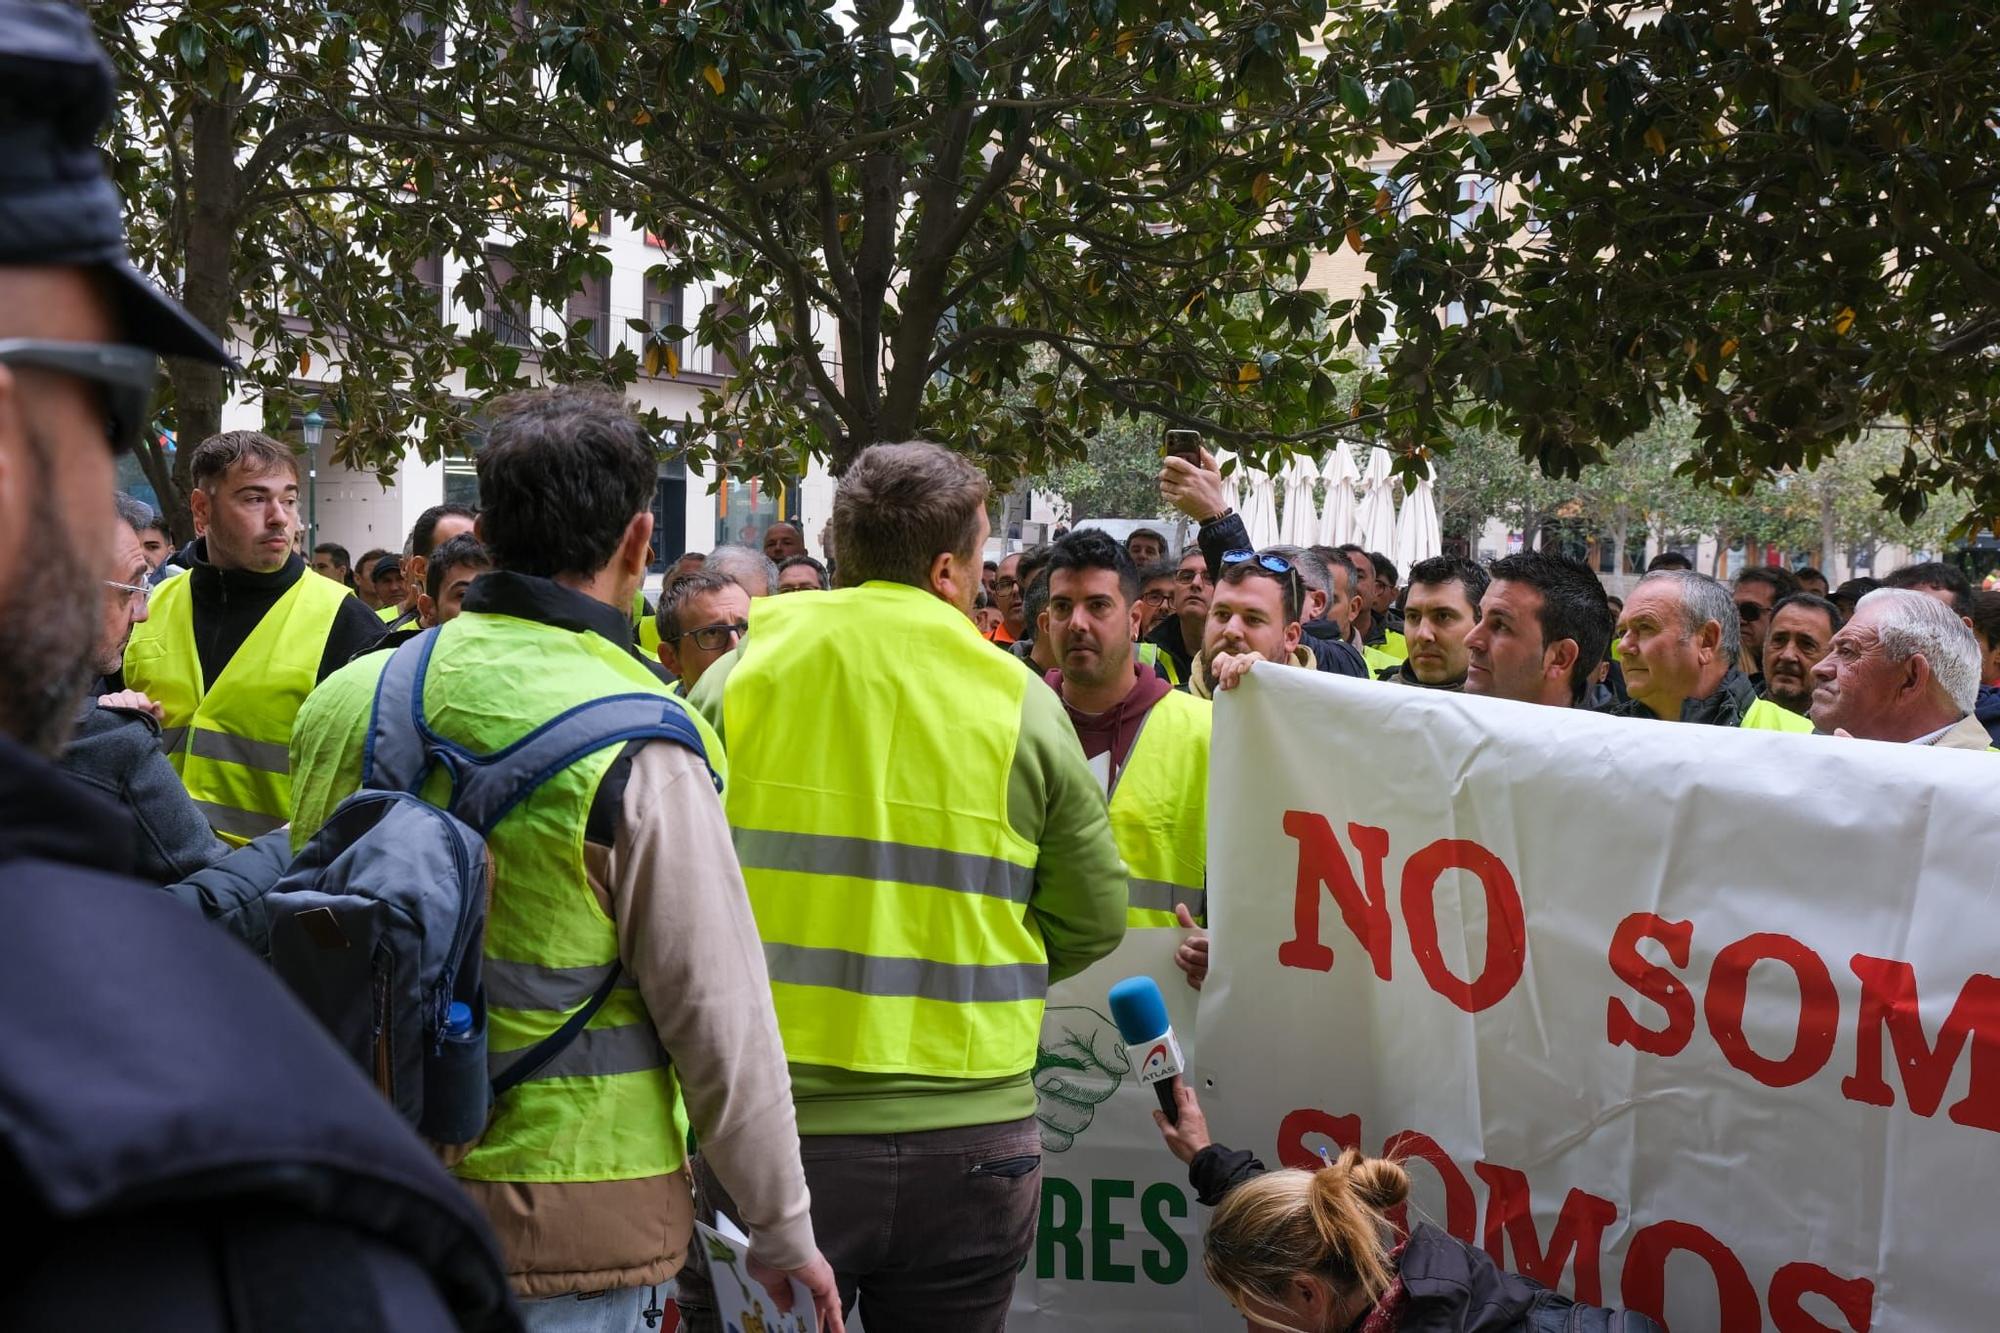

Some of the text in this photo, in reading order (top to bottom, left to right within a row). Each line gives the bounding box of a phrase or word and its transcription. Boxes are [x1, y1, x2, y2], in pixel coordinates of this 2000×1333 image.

[1279, 810, 2000, 1132] NO SOM
[1142, 1065, 1176, 1082] ATLAS
[1017, 1177, 1188, 1285] RES
